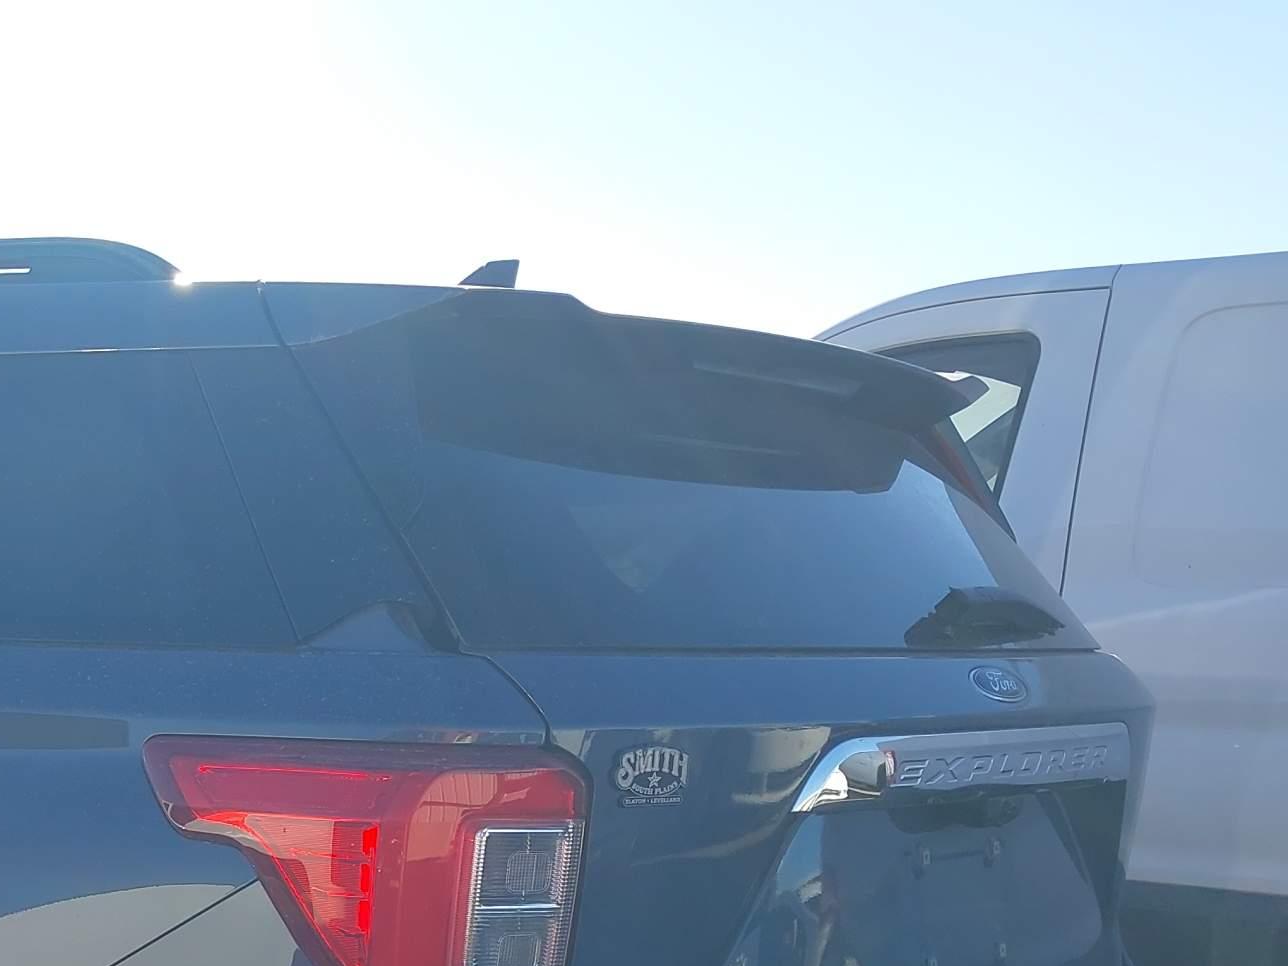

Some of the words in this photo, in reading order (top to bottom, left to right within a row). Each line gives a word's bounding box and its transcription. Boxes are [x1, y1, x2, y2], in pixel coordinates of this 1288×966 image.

[985, 671, 1017, 691] Ford
[617, 747, 689, 787] SMITH
[892, 744, 1108, 787] EXPLORER
[632, 783, 654, 795] SOUTH
